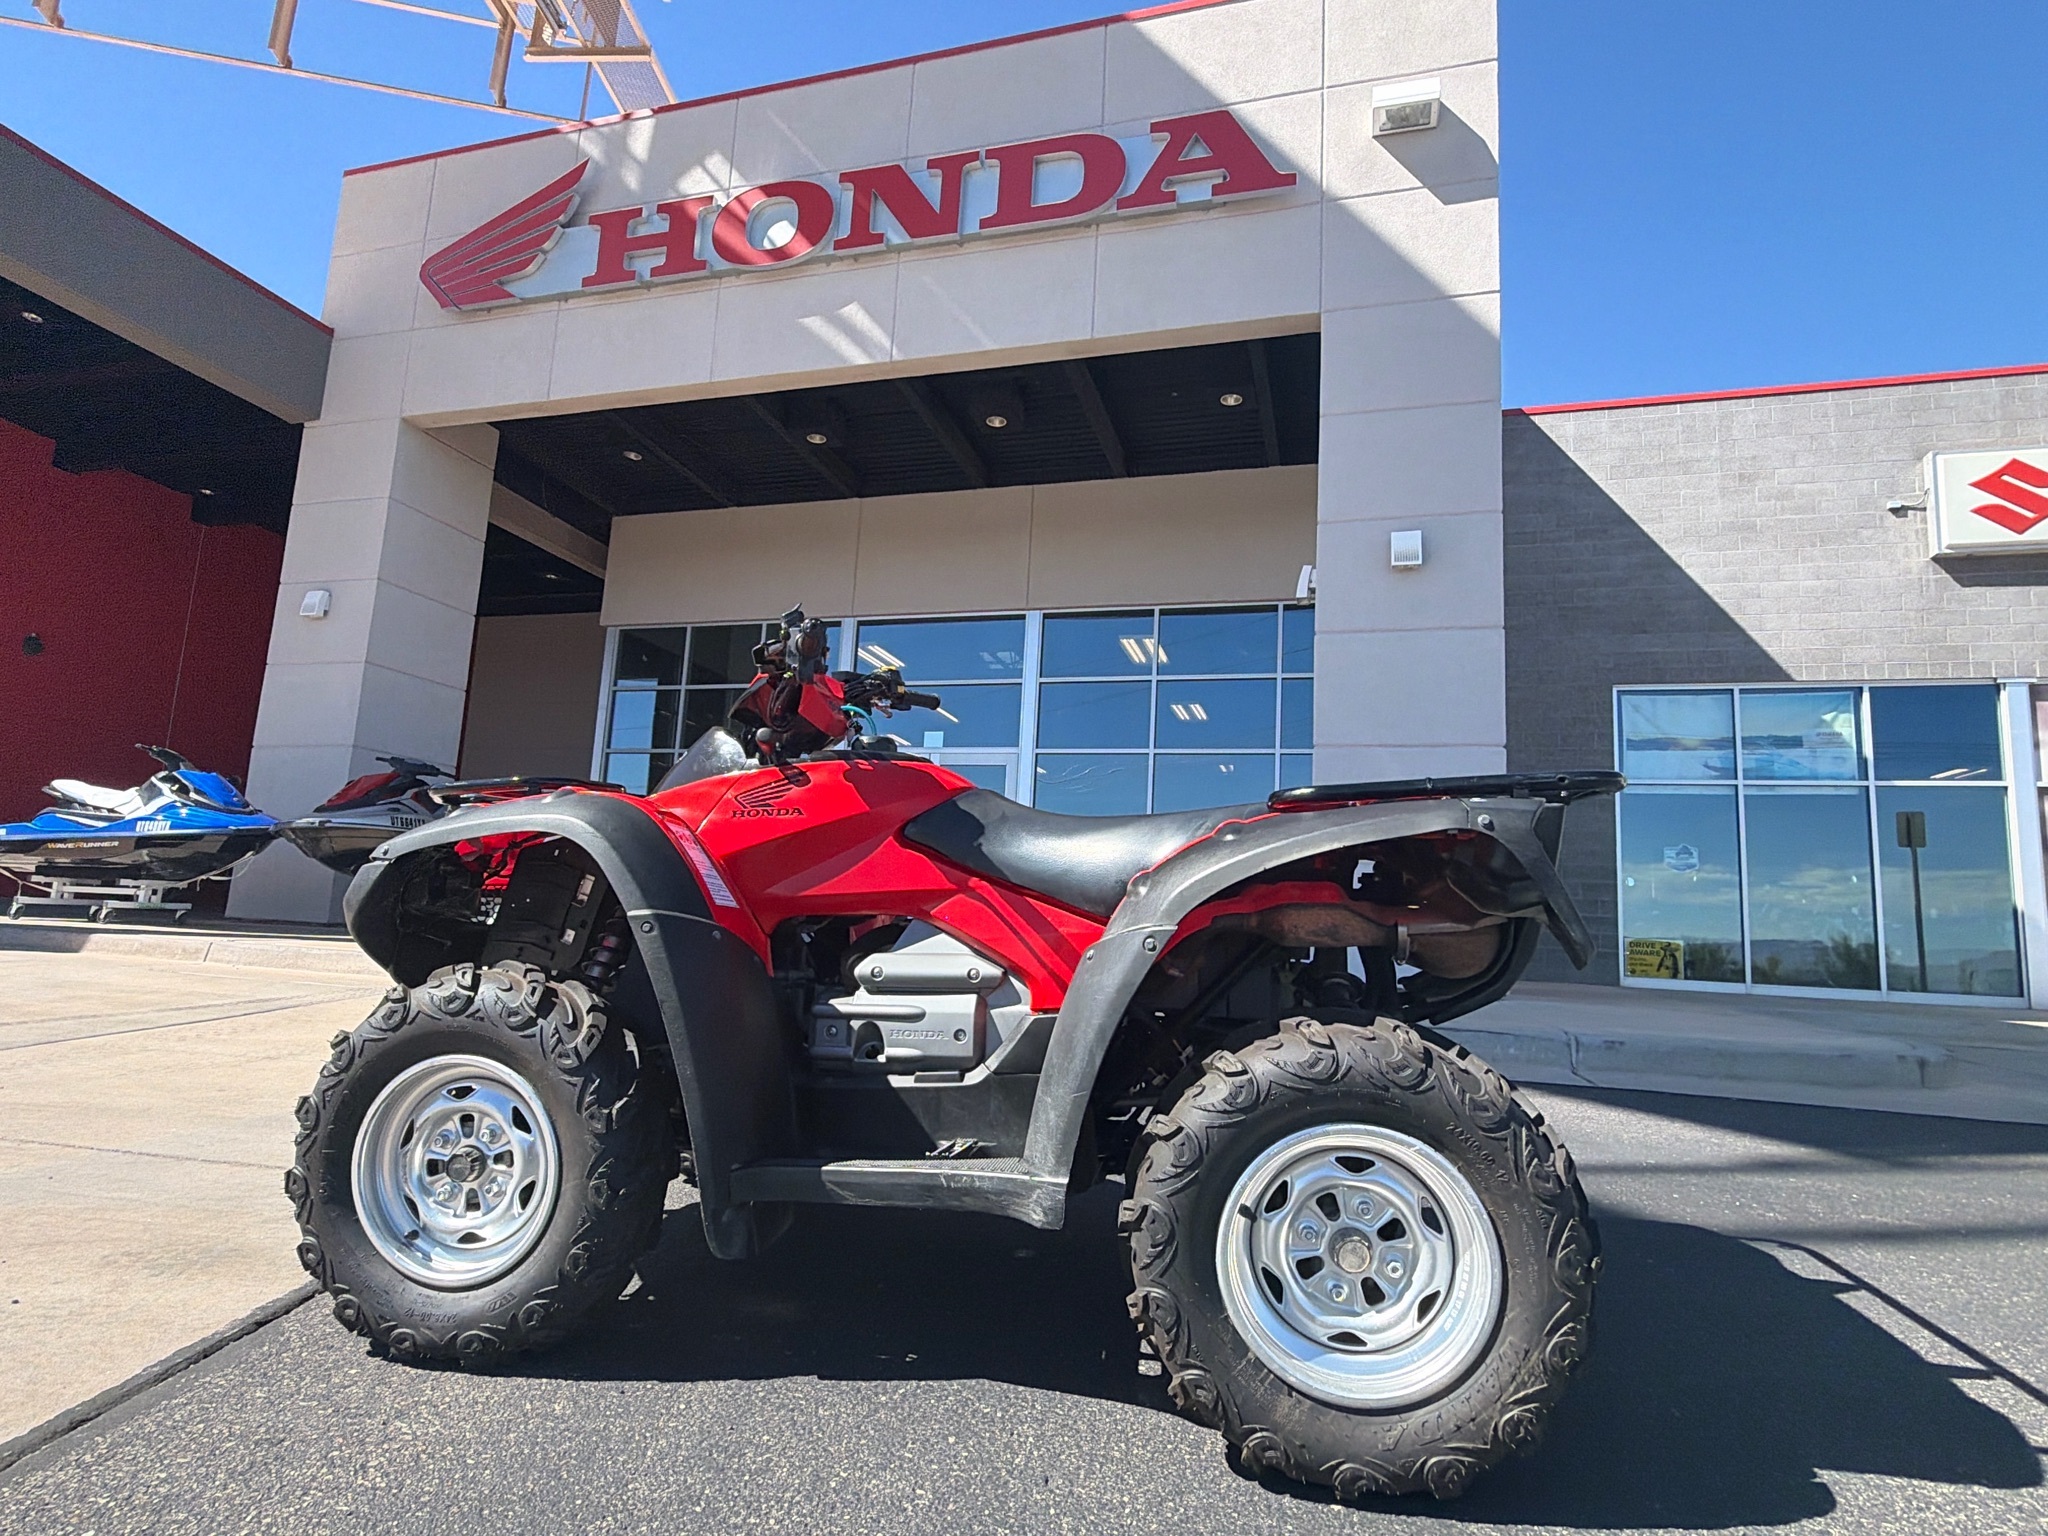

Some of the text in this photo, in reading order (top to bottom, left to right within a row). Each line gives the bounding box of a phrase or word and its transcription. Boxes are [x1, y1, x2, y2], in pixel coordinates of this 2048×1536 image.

[580, 109, 1297, 289] HONDA
[732, 807, 804, 819] HONDA
[1628, 941, 1656, 949] DRIVE
[1628, 949, 1661, 957] AWARE
[889, 1029, 949, 1040] HONDA
